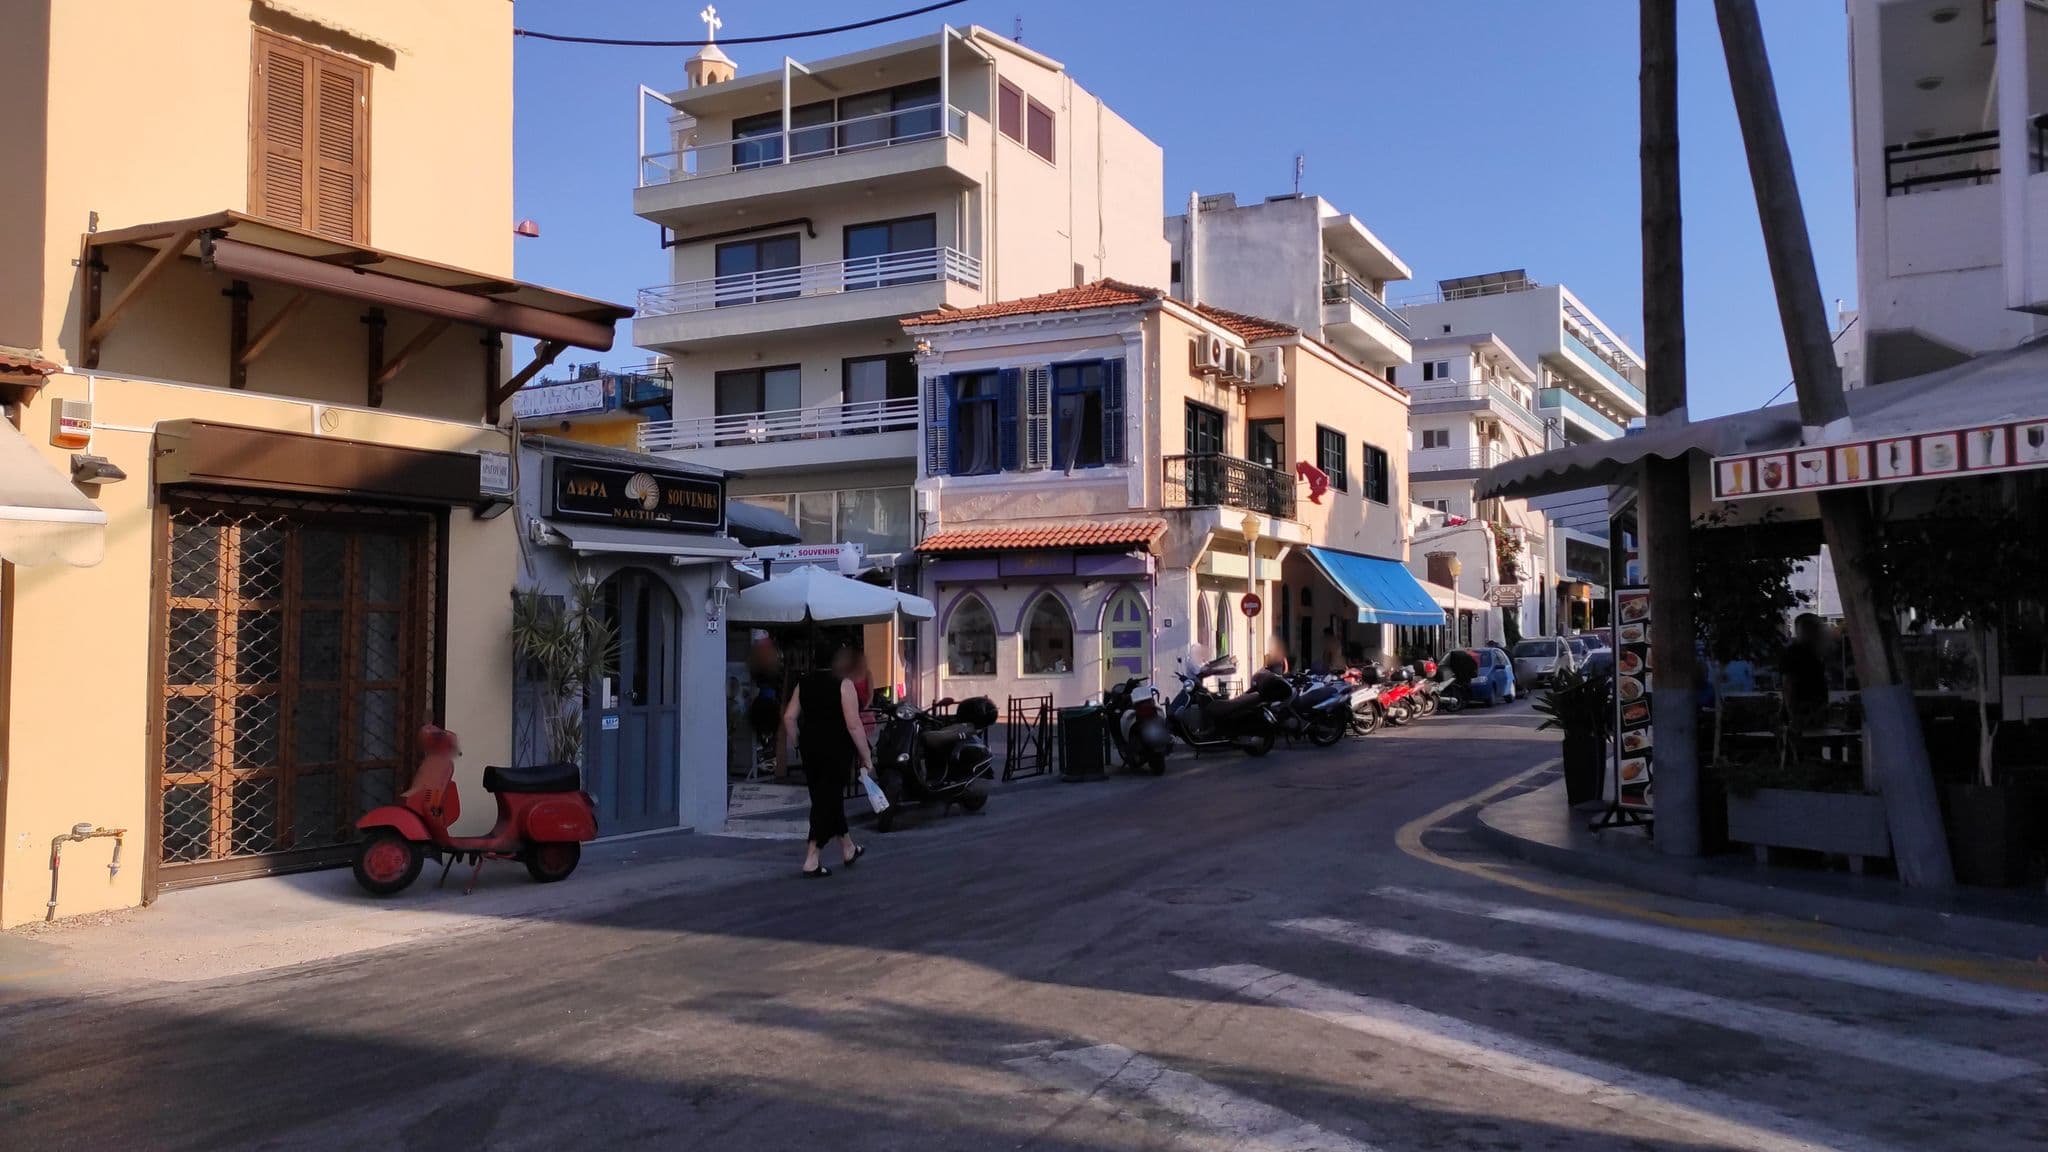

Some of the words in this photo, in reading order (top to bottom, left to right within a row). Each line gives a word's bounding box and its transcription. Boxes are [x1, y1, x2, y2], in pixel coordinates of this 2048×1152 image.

[566, 479, 608, 498] ΔΩΡΑ
[667, 489, 718, 509] SOUVENIRS
[613, 507, 672, 521] NAUTILOS
[798, 548, 840, 556] SOUVENIRS
